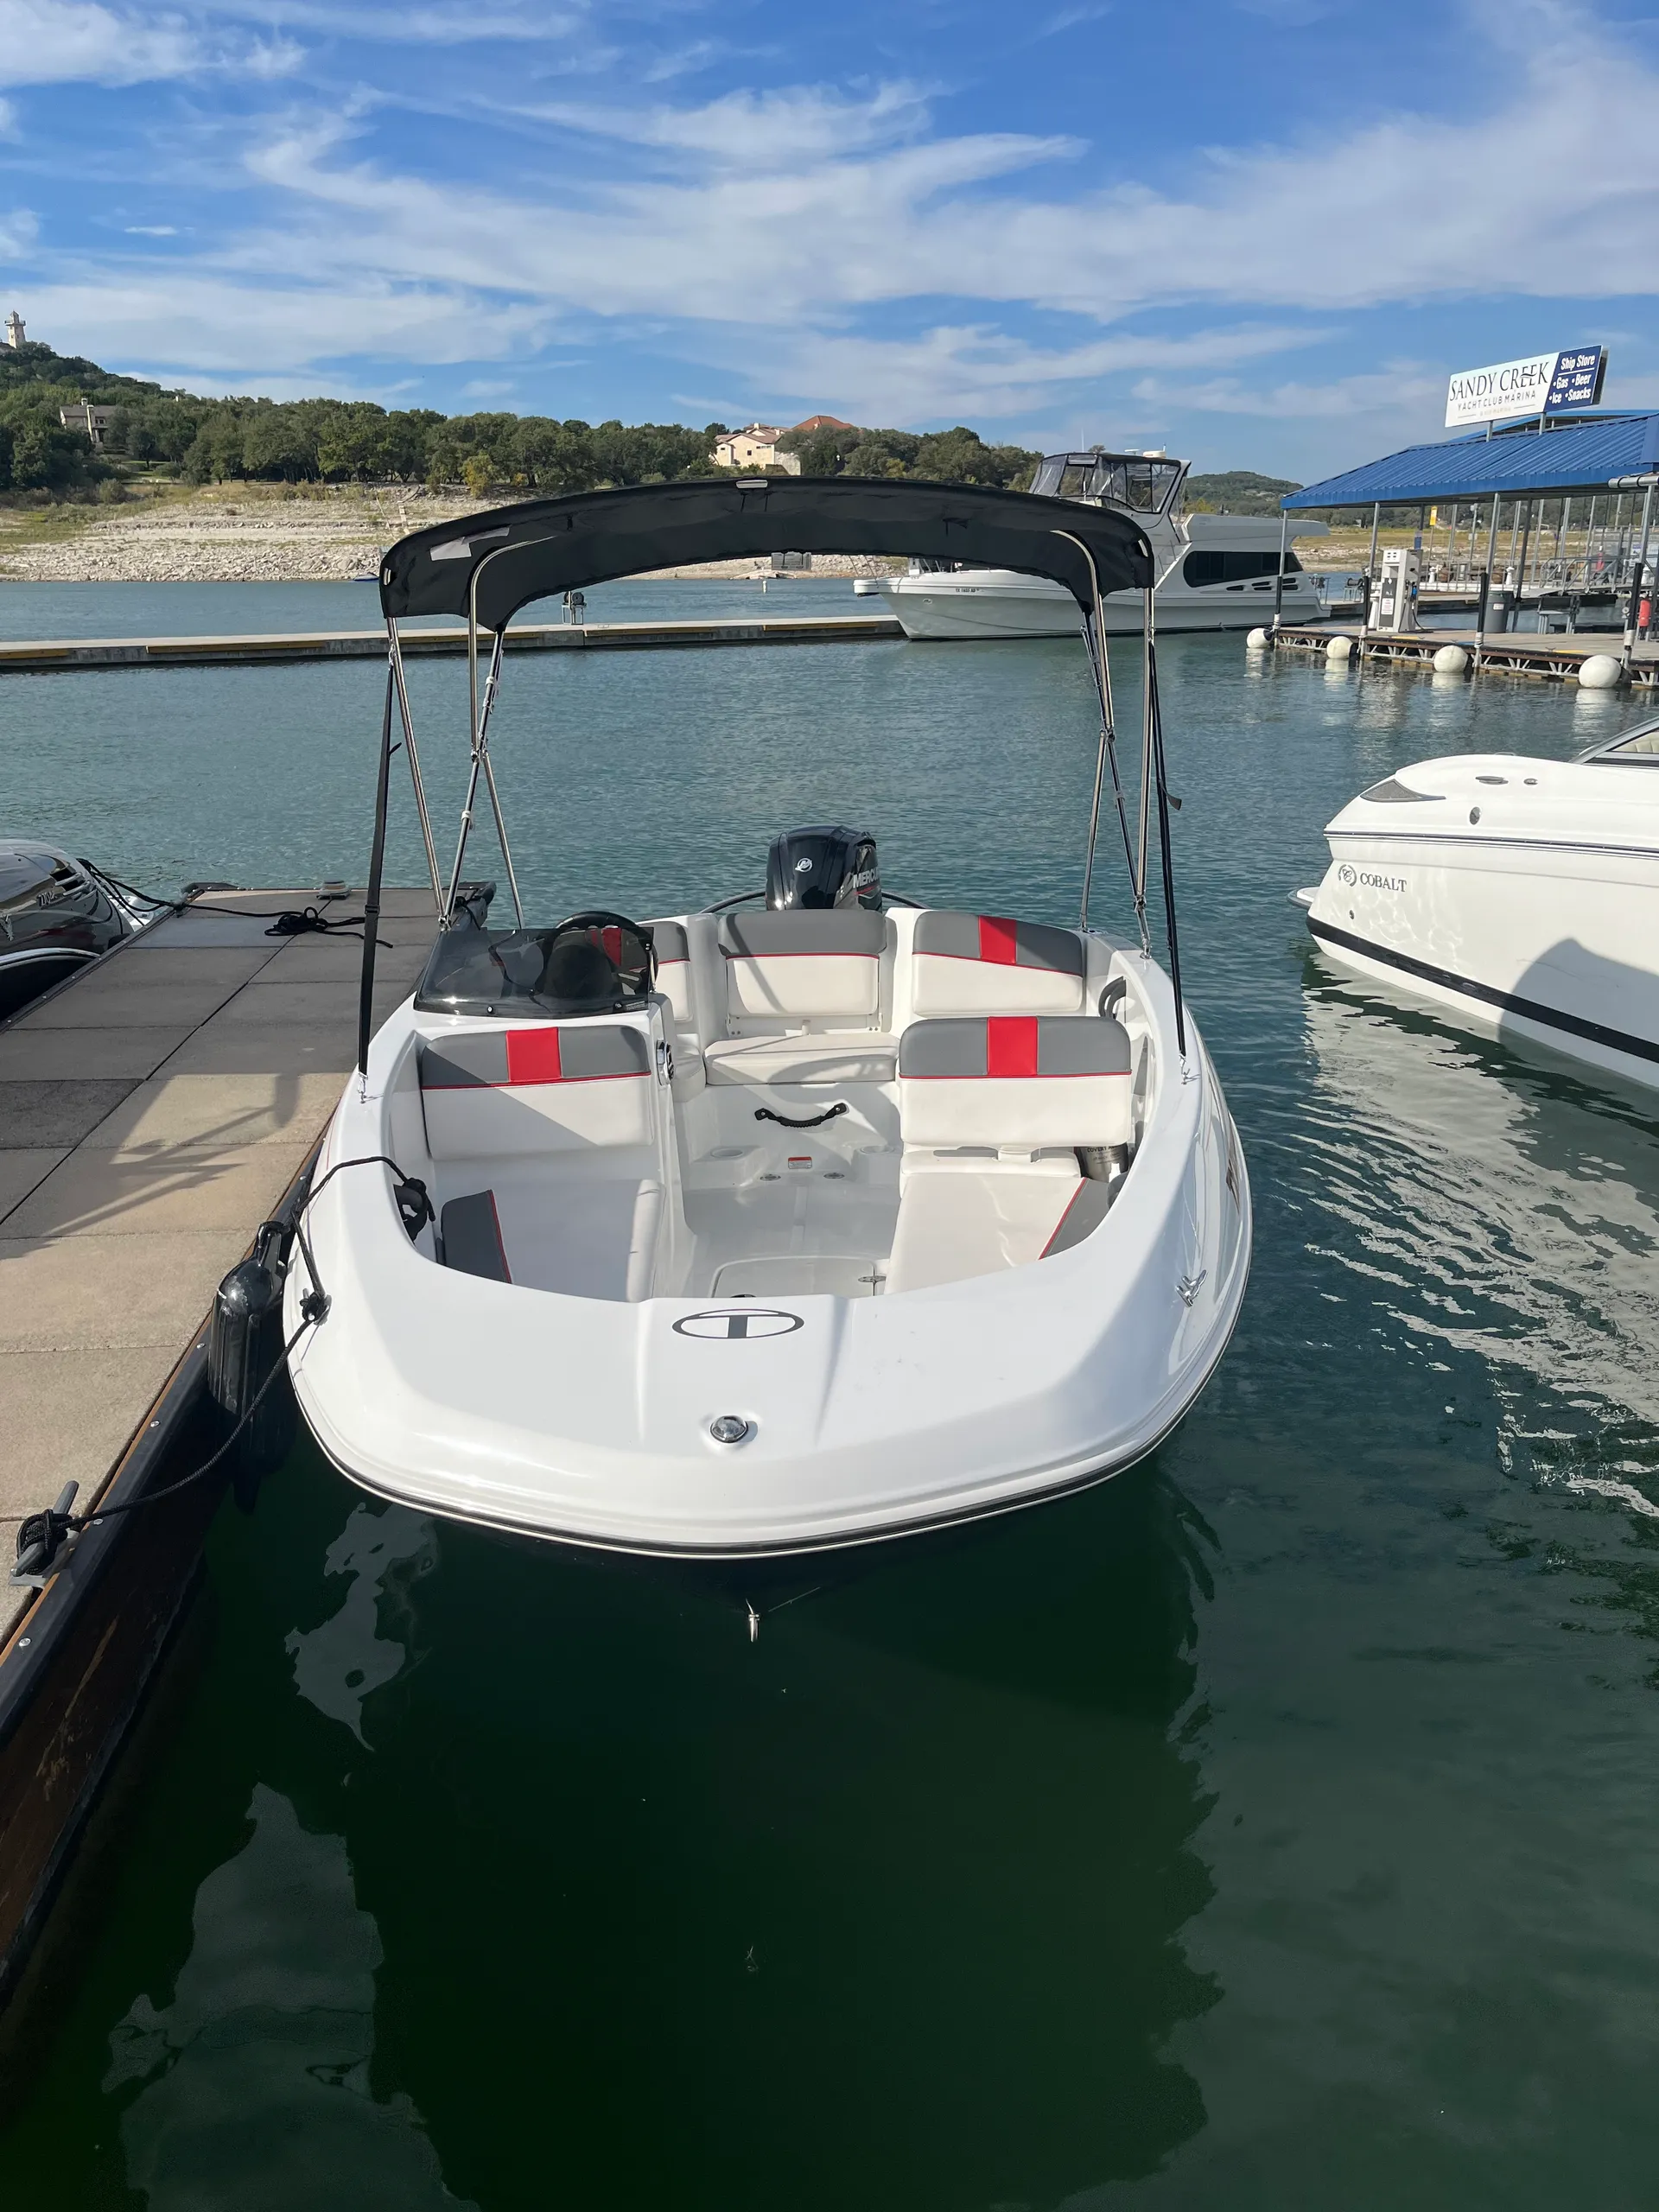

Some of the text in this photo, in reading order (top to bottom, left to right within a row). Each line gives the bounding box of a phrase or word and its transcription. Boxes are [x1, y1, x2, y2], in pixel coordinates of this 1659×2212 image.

[1560, 355, 1595, 371] Ship Store
[1450, 361, 1550, 401] SANDY CREEK
[1458, 390, 1536, 411] YACHT CLUB MARINA
[1567, 387, 1591, 402] Snacks
[853, 868, 879, 889] MERCU
[1360, 872, 1408, 893] COBALT
